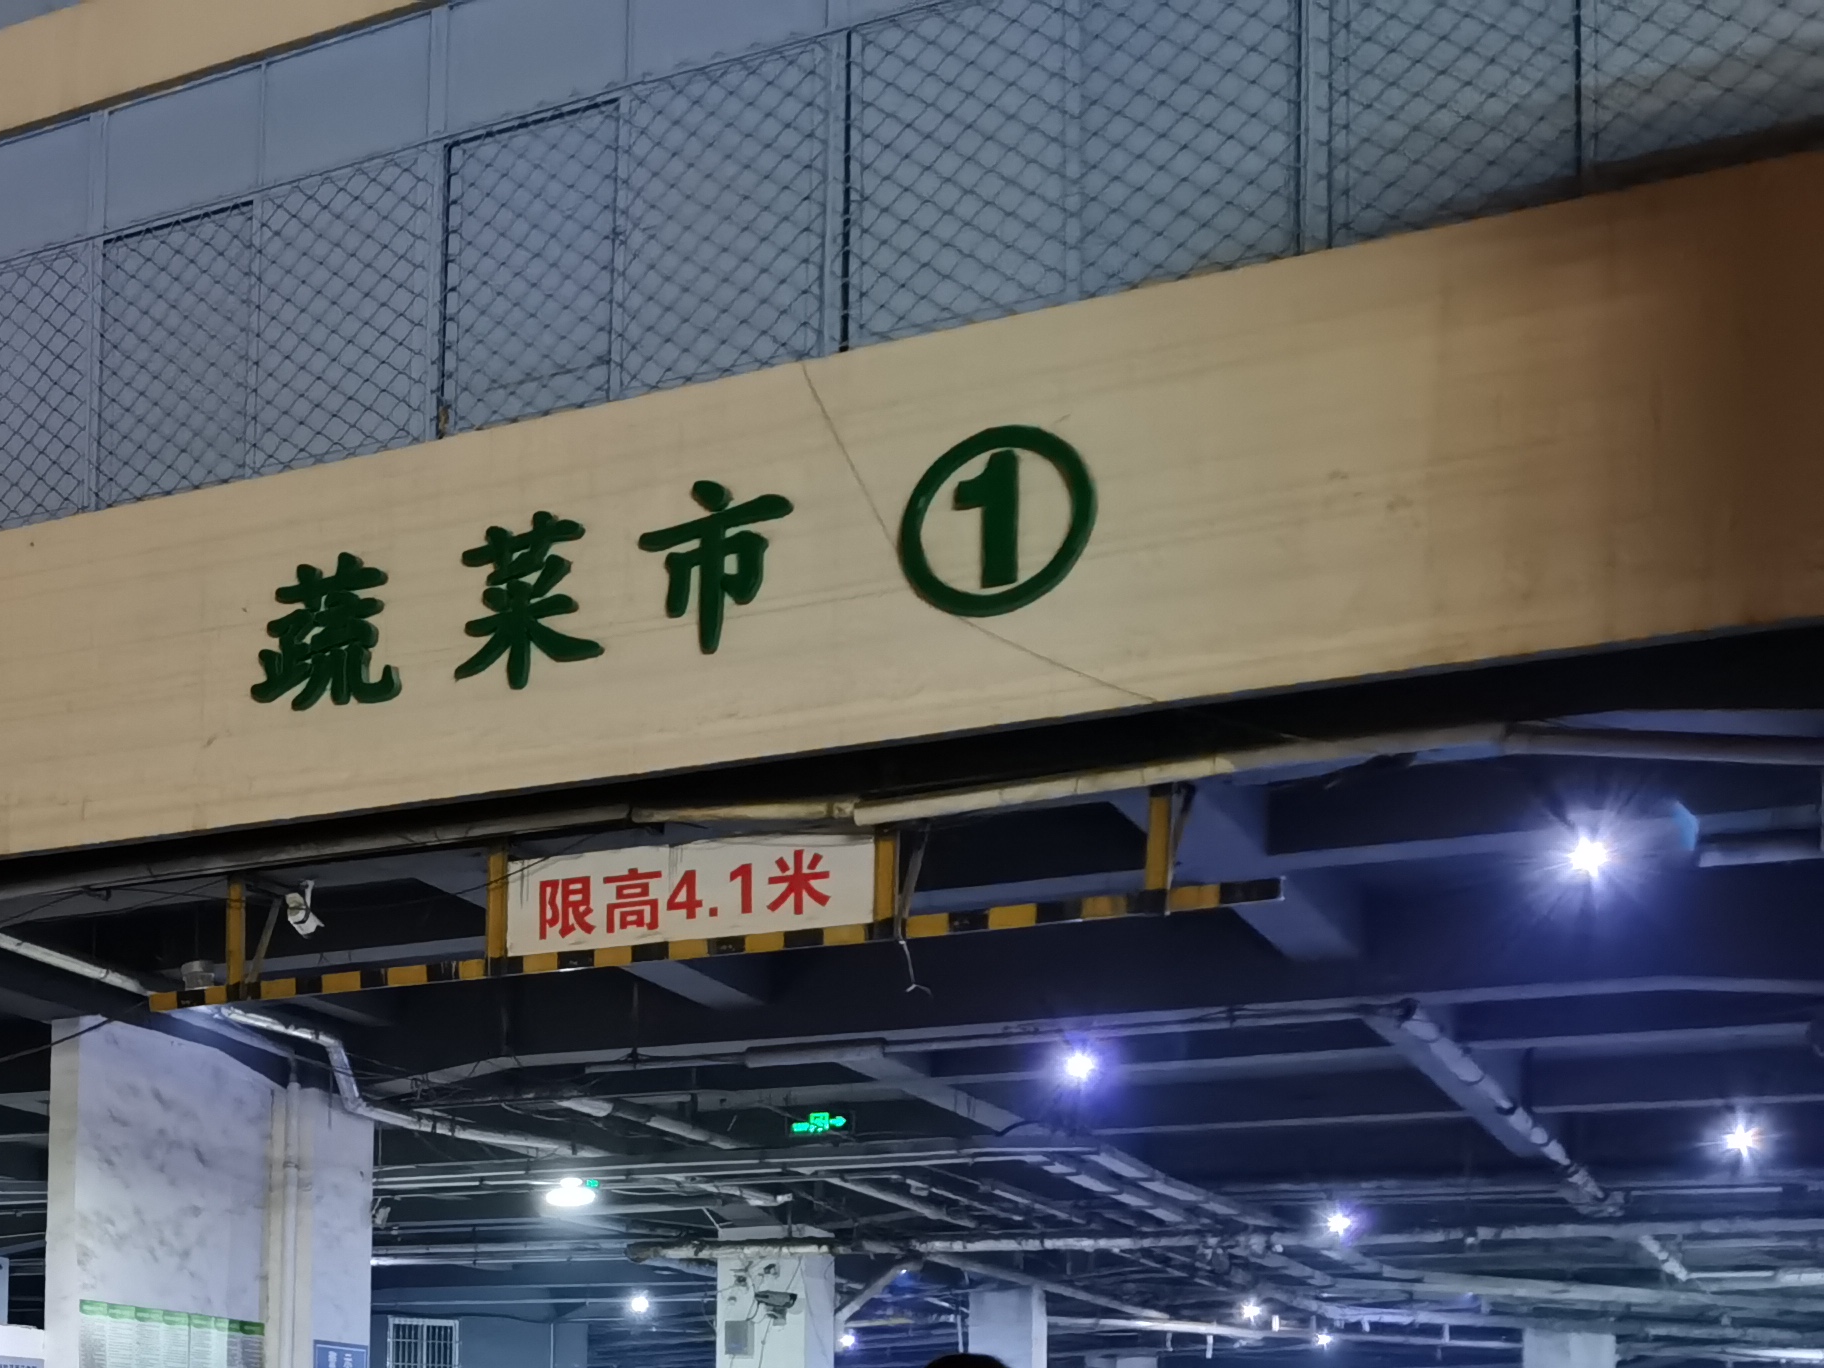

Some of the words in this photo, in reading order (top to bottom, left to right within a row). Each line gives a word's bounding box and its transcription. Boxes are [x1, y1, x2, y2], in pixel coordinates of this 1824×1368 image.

[249, 478, 794, 711] 蔬菜市
[538, 848, 832, 940] 限高4.1米
